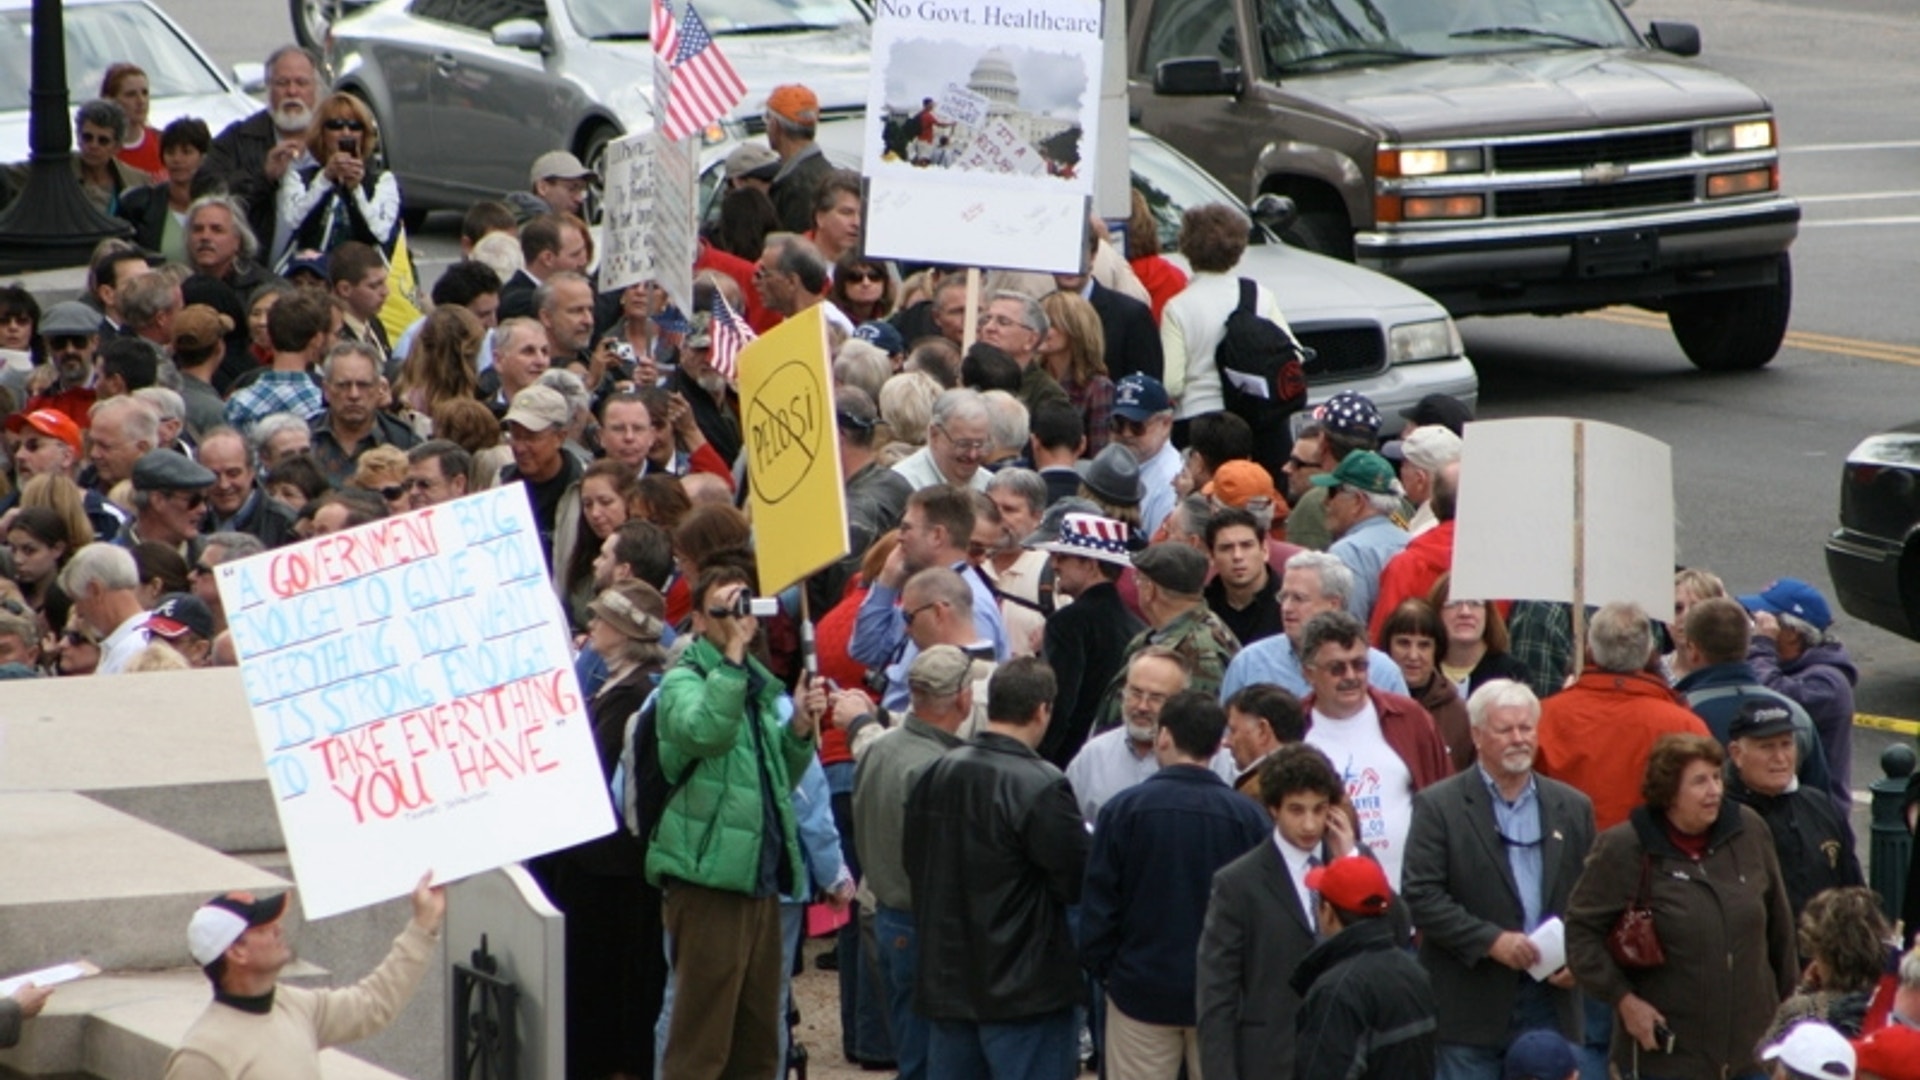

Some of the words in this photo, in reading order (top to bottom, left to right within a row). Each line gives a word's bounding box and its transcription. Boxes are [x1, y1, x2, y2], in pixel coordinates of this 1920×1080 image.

[878, 0, 911, 19] No
[917, 1, 976, 24] Govt.
[984, 5, 1097, 33] Healthcare
[230, 590, 341, 658] ENOUGH
[340, 577, 392, 626] TO
[403, 552, 475, 609] GIVE
[489, 536, 541, 582] YOU
[269, 510, 439, 598] GOVERNMENT
[453, 492, 517, 545] BIG
[241, 623, 398, 706] EVERYTHING
[405, 611, 467, 655] YOU
[476, 579, 545, 638] WANT
[269, 700, 316, 748] IS
[320, 663, 435, 735] STRONG
[441, 636, 546, 698] ENOUGH
[267, 753, 309, 795] TO
[310, 721, 396, 781] TAKE
[402, 669, 577, 758] EVERYTHING
[332, 761, 433, 823] YOU
